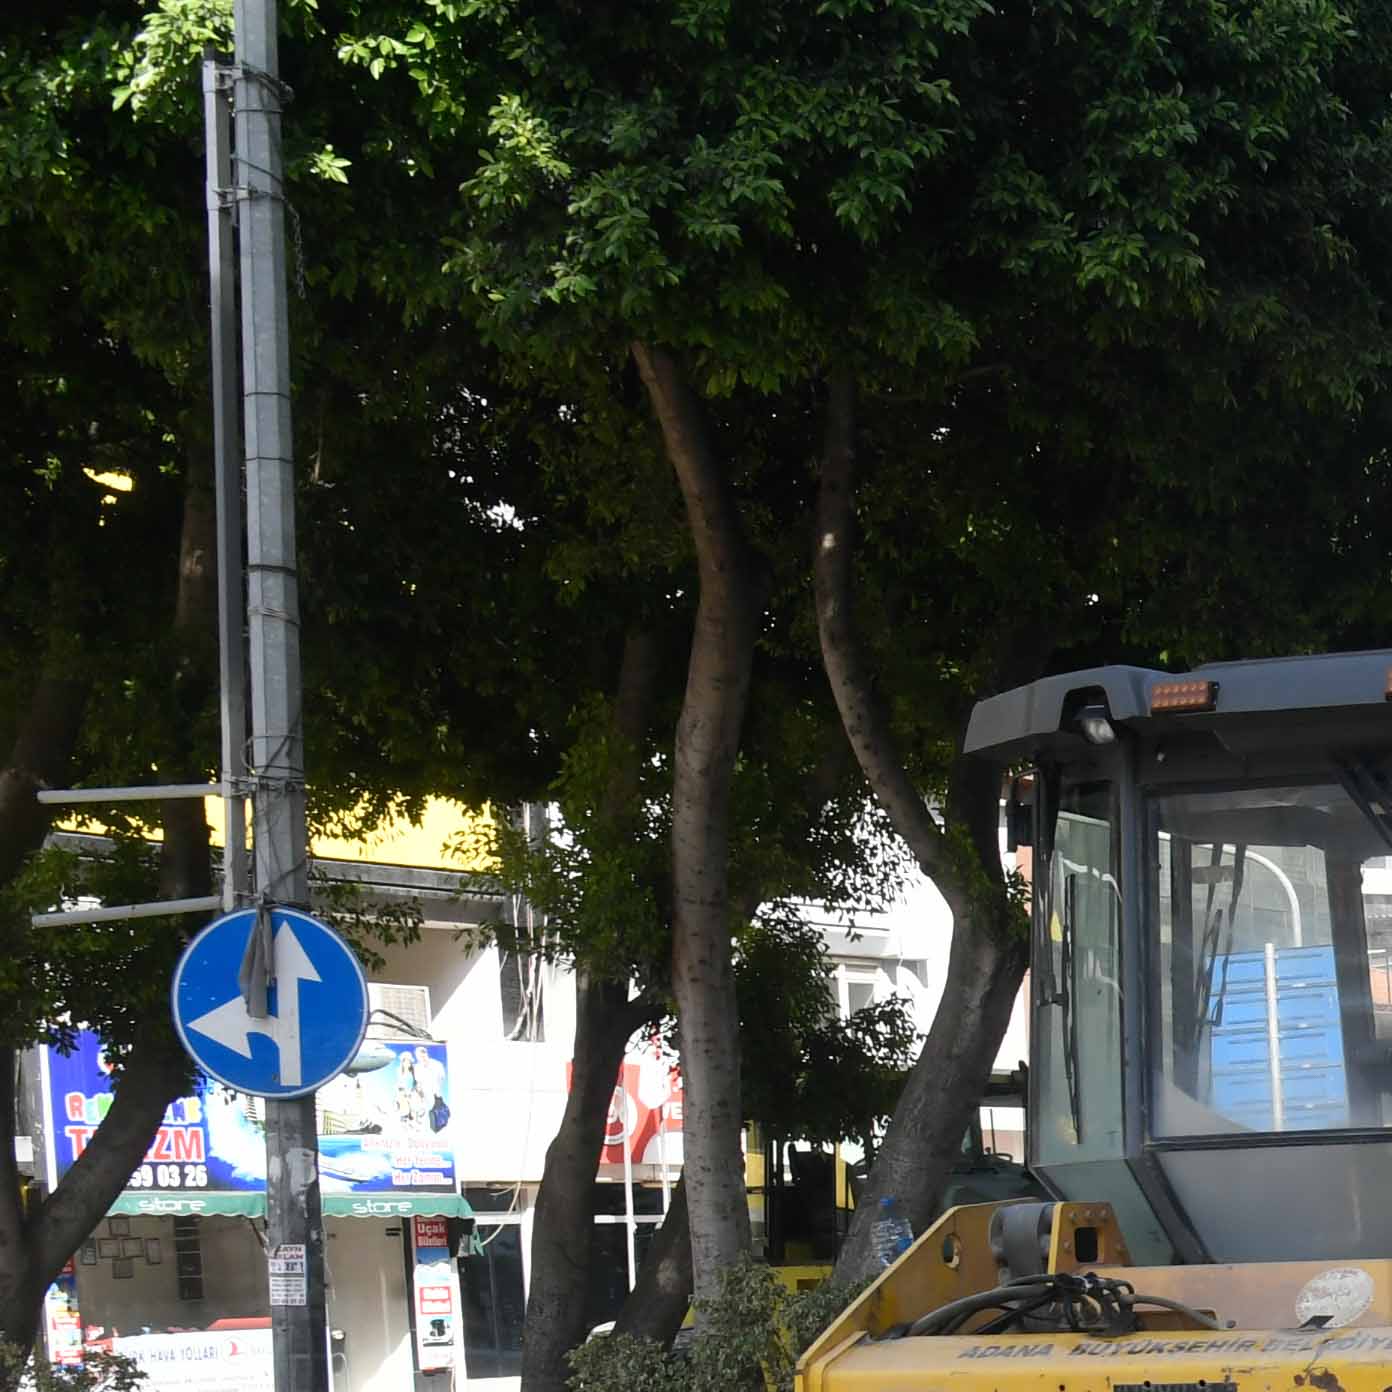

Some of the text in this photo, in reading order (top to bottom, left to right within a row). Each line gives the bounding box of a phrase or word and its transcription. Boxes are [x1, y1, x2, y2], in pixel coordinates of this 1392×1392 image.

[157, 1165, 180, 1187] 03
[184, 1165, 207, 1187] 26
[139, 1199, 206, 1211] store
[352, 1200, 413, 1213] store
[957, 1343, 1055, 1360] ADANA
